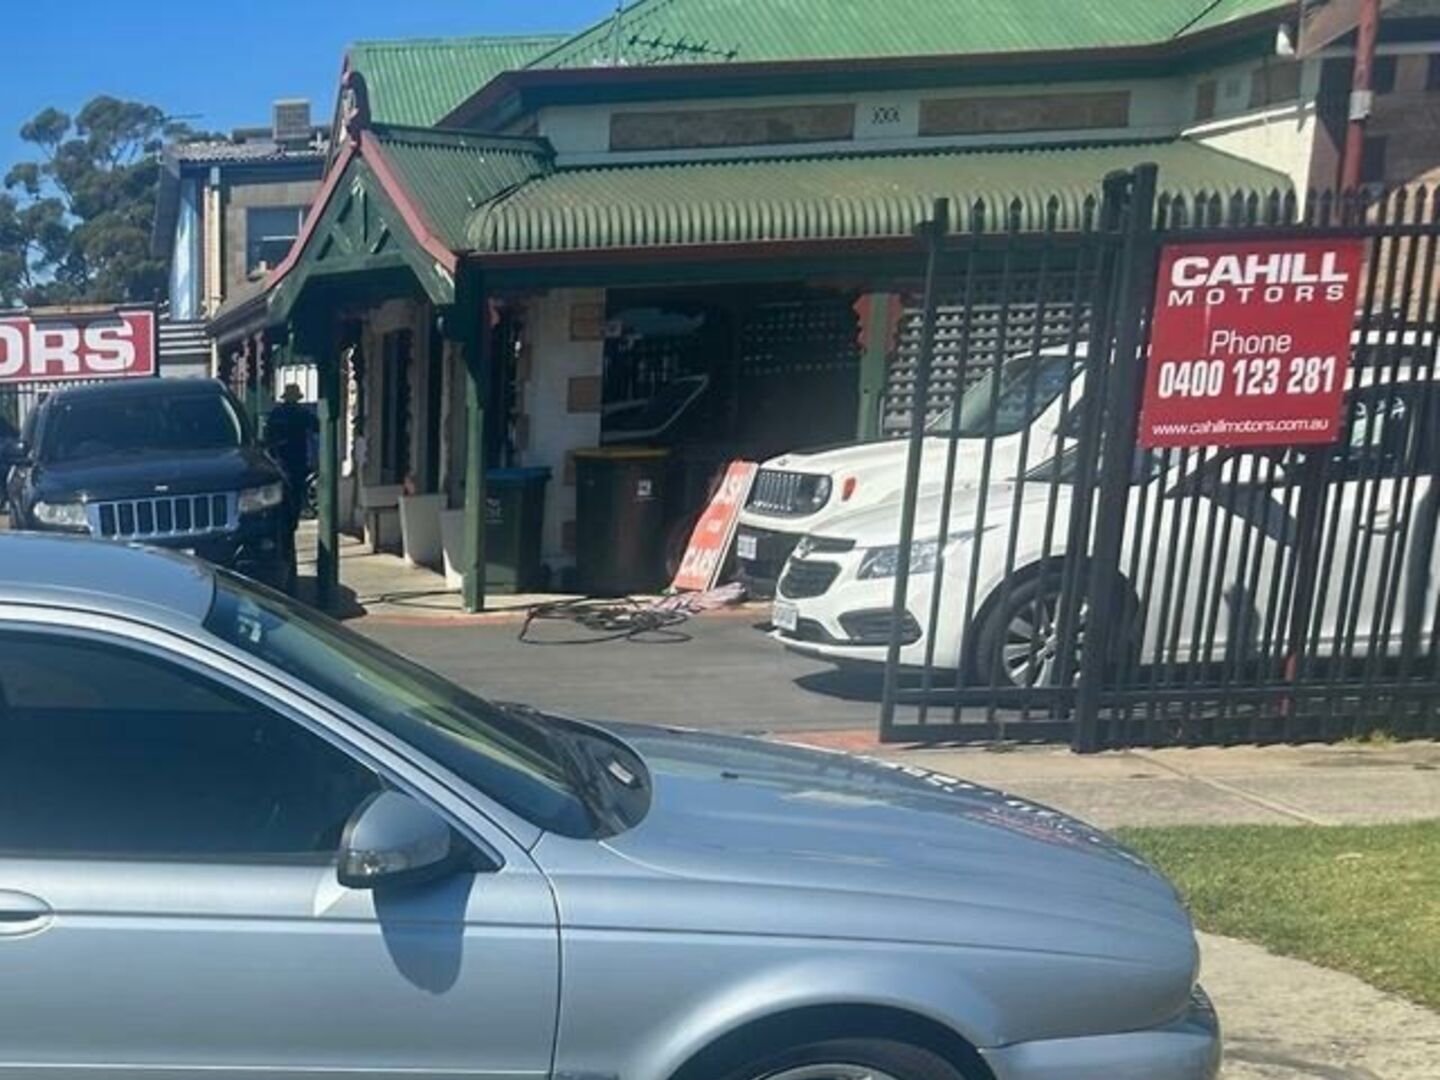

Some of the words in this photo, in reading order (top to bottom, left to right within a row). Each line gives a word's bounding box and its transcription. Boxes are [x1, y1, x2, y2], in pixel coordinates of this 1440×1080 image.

[1170, 251, 1349, 287] CAHILL
[1167, 285, 1345, 307] MOTORS
[1210, 329, 1292, 355] Phone
[1158, 359, 1226, 399] 0400
[1231, 358, 1281, 396] 123
[1286, 356, 1337, 394] 281
[1152, 418, 1329, 435] www.cahillmotors.com.au
